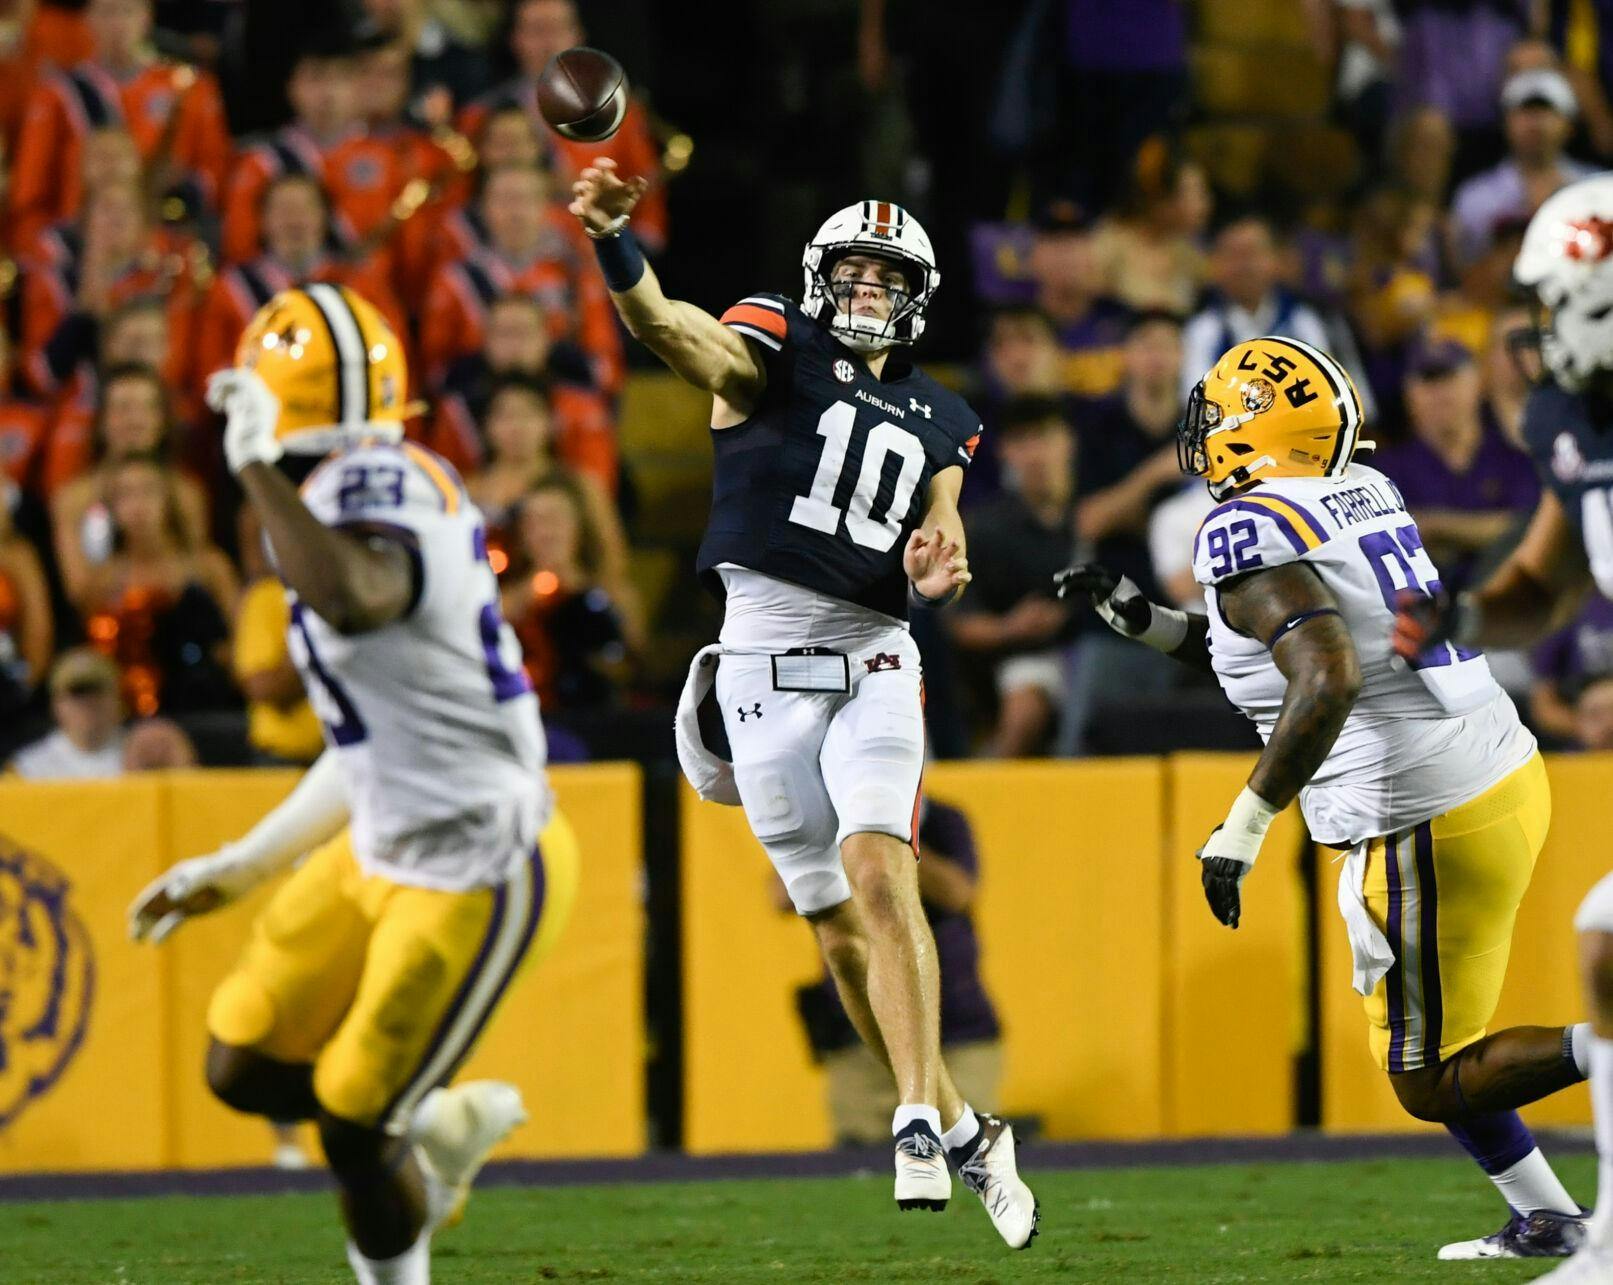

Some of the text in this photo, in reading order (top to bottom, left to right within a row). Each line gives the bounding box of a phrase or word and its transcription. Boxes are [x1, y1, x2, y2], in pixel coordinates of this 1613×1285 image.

[833, 359, 855, 383] SEC
[854, 389, 906, 419] AUBURN
[339, 465, 405, 511] 23
[788, 400, 926, 552] 10
[1319, 480, 1406, 530] FARRELL J
[1207, 518, 1264, 578] 92
